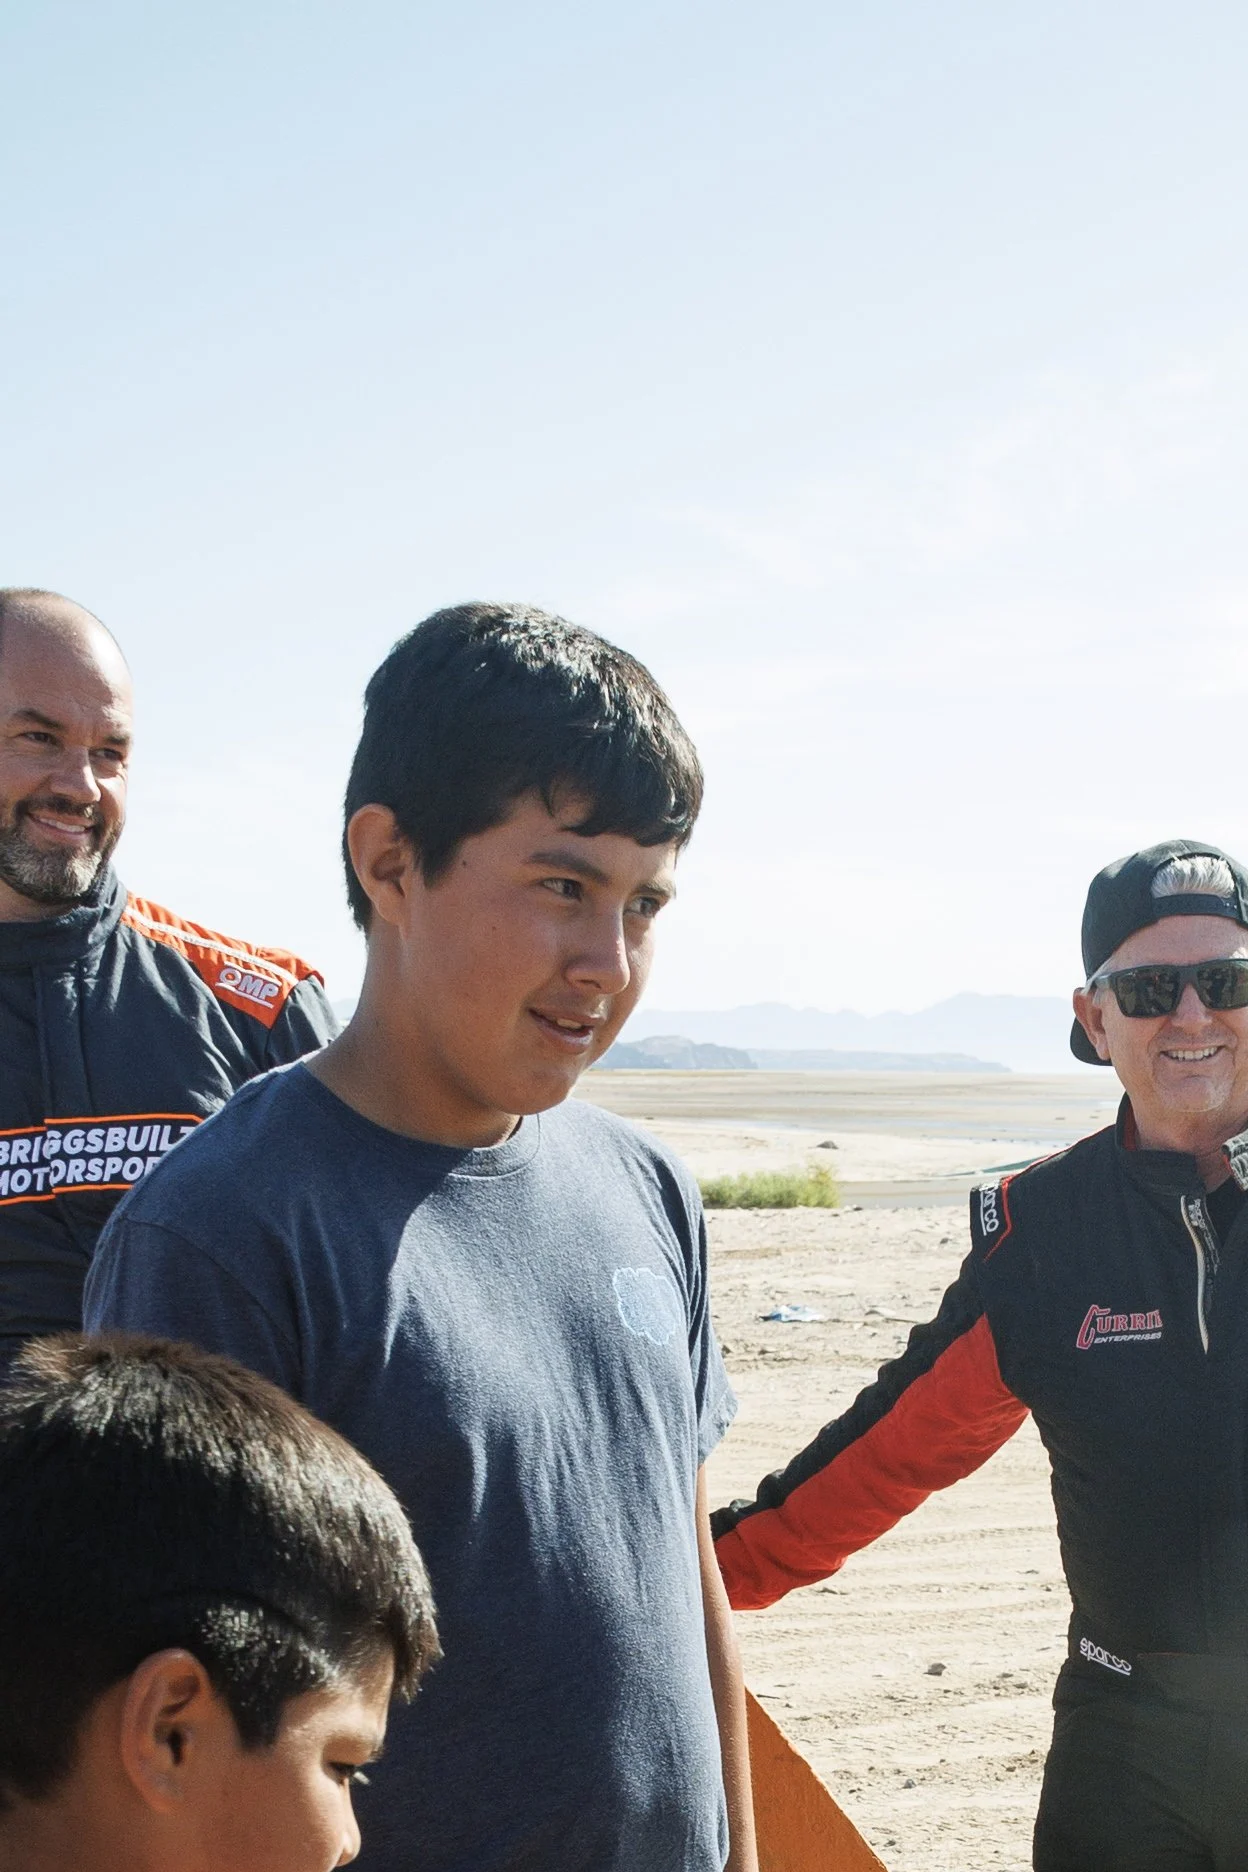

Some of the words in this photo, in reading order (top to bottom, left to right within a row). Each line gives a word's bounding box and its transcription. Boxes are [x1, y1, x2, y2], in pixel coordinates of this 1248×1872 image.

[219, 966, 279, 1001] OMP
[1094, 1331, 1162, 1344] ENTERPRISES
[1080, 1637, 1132, 1673] sparco
